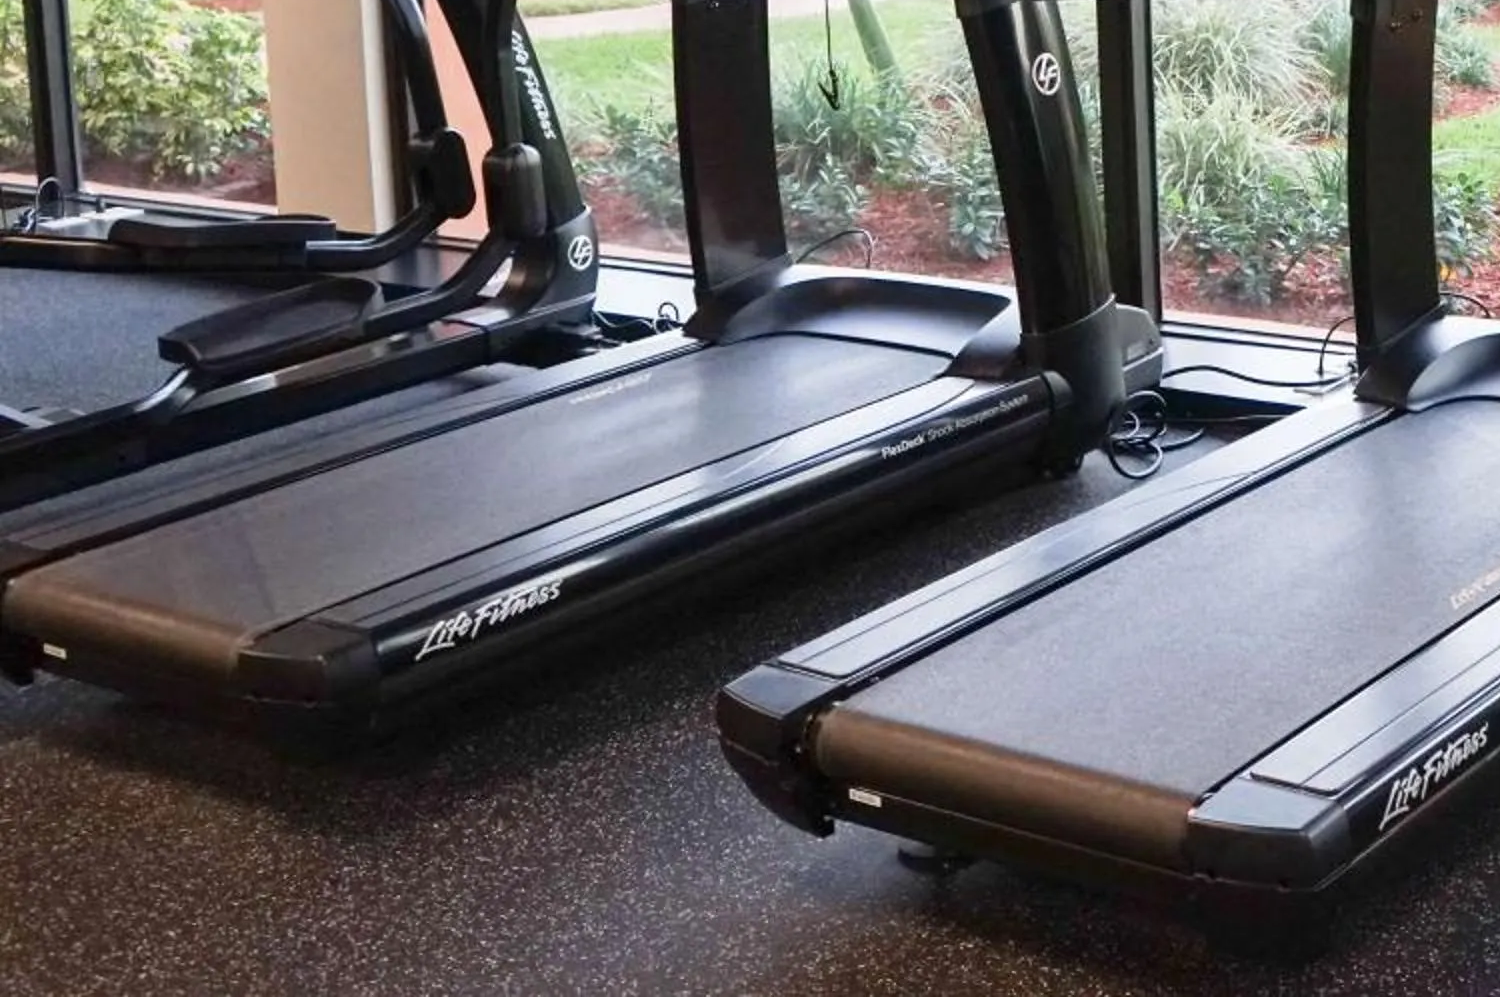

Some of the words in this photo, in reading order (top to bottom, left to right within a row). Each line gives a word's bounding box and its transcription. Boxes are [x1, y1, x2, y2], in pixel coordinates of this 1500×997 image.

[415, 611, 473, 661] Life
[471, 579, 562, 640] Fitness
[1378, 768, 1422, 831] Life
[1421, 721, 1489, 800] Fitness
